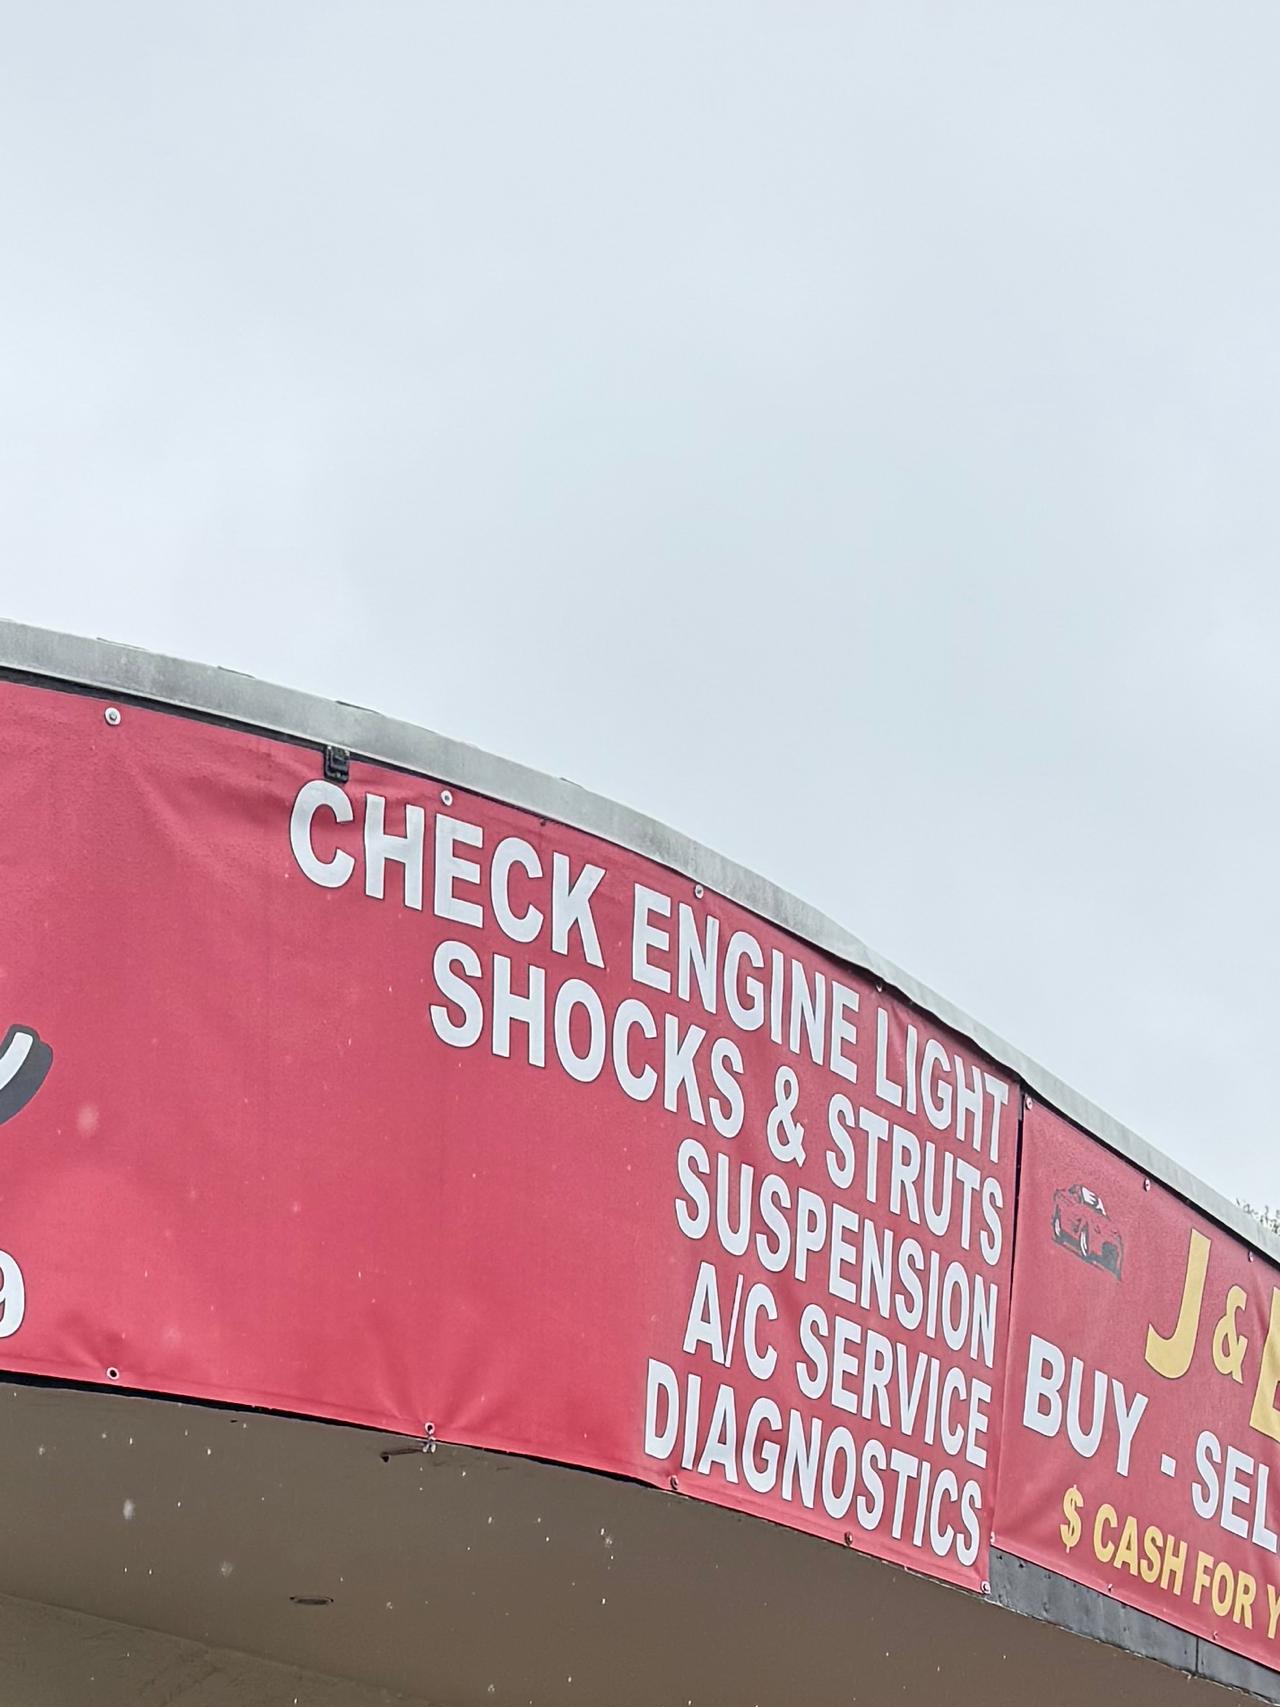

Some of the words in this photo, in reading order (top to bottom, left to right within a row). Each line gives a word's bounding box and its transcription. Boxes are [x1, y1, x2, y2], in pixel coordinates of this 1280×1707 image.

[288, 779, 607, 969] CHECK
[631, 883, 860, 1084] ENGINE
[875, 1008, 1009, 1163] LIGHT
[428, 940, 746, 1139] SHOCKS
[767, 1067, 807, 1168] &
[826, 1093, 1005, 1268] STRUTS
[674, 1138, 998, 1371] SUSPENSION
[643, 1358, 984, 1567] DIAGNOSTICS
[682, 1262, 778, 1381] A/C
[796, 1303, 991, 1470] SERVICE
[1022, 1334, 1148, 1478] BUY
[1060, 1485, 1084, 1554] $
[1092, 1504, 1189, 1597] CASH
[1192, 1554, 1253, 1632] FOR
